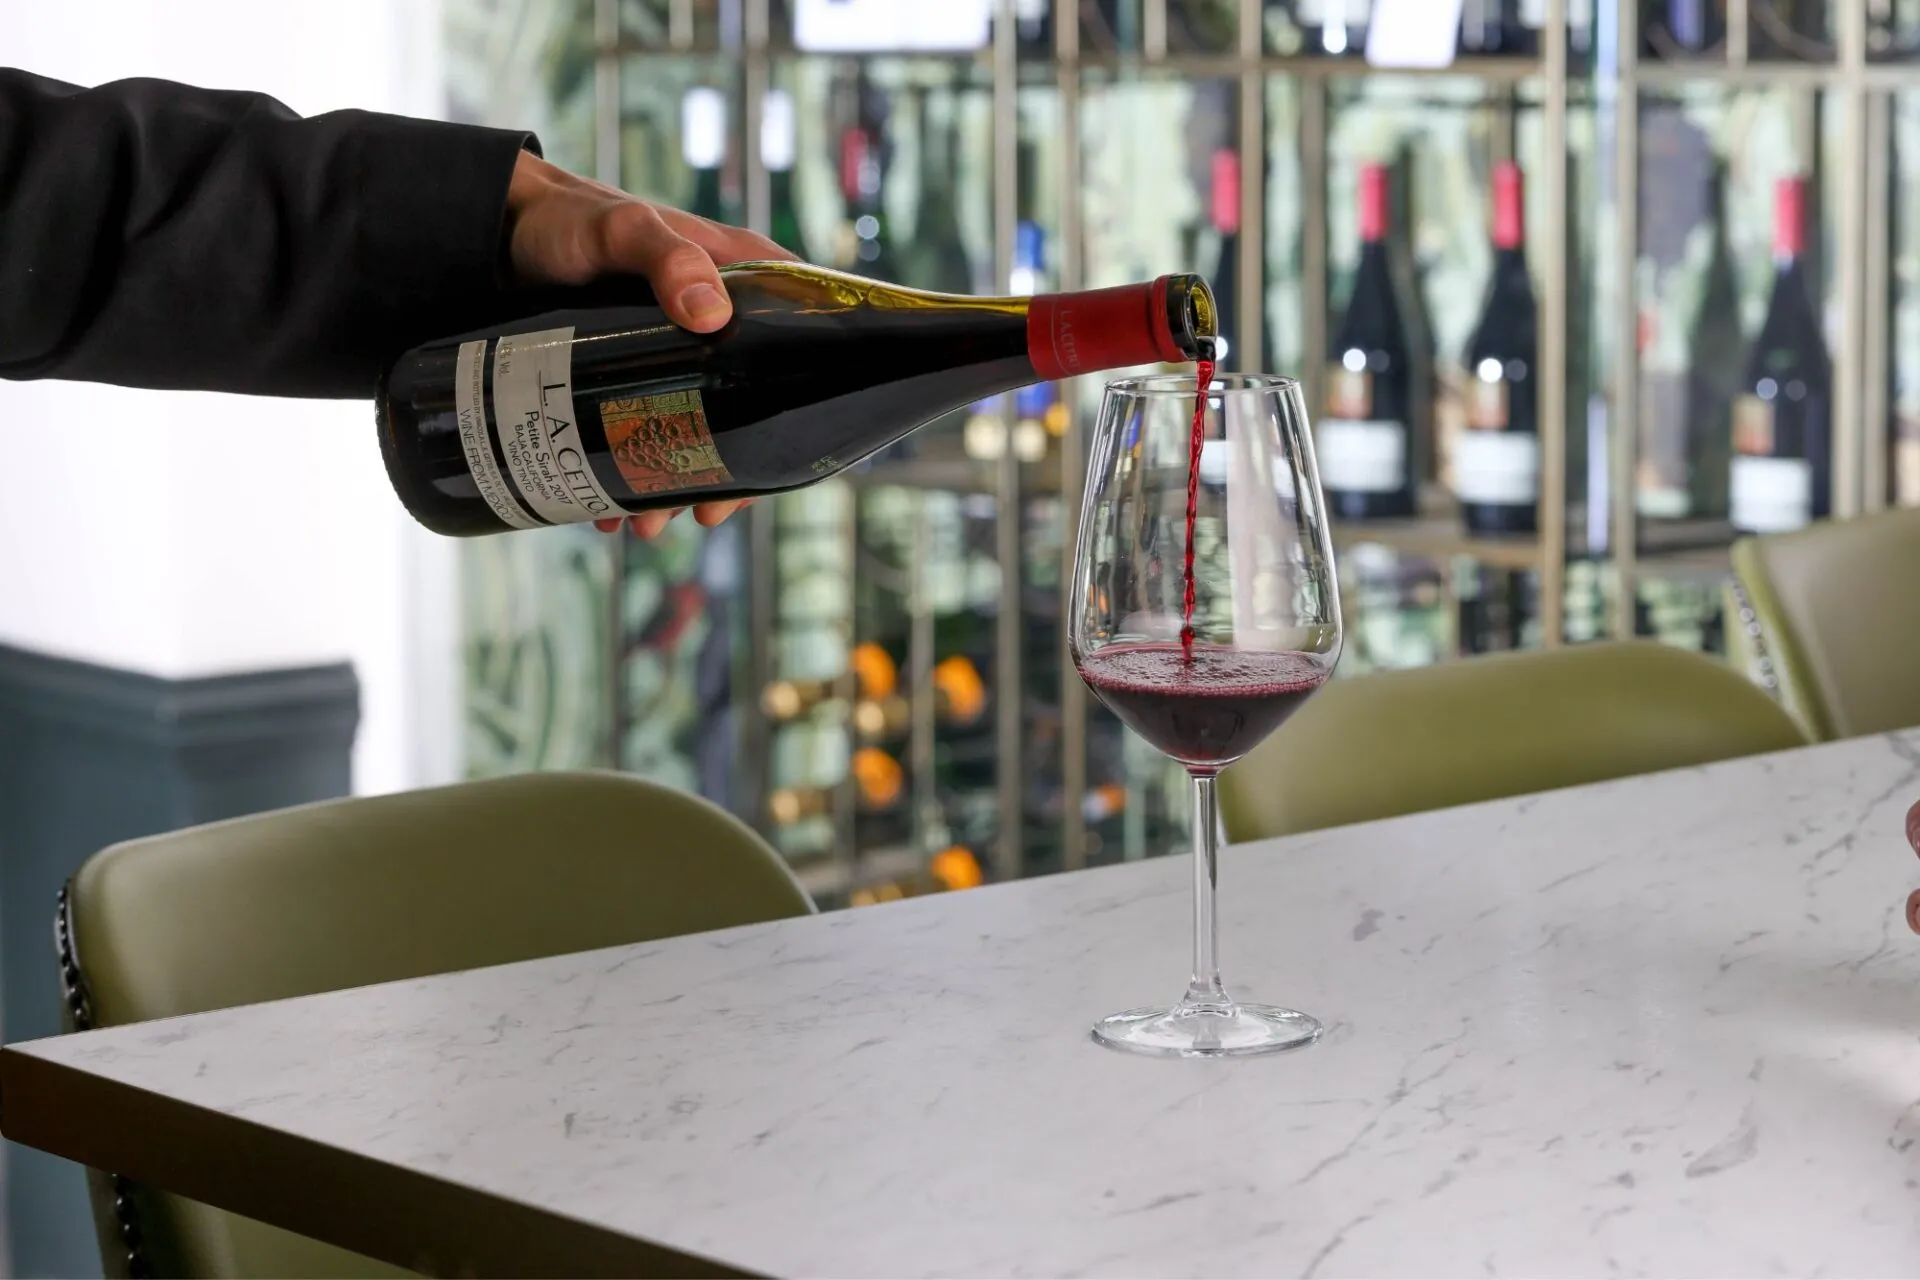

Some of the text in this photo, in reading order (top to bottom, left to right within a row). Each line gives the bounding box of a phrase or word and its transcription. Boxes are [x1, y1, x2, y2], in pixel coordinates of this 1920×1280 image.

[459, 408, 476, 445] WINE
[467, 447, 488, 486] FROM
[507, 441, 535, 493] VINO TINTO
[514, 424, 528, 449] BAJA
[521, 449, 552, 500] CALIFORNIA
[525, 410, 574, 505] Petite Sirah 2017
[557, 447, 609, 514] CETTO
